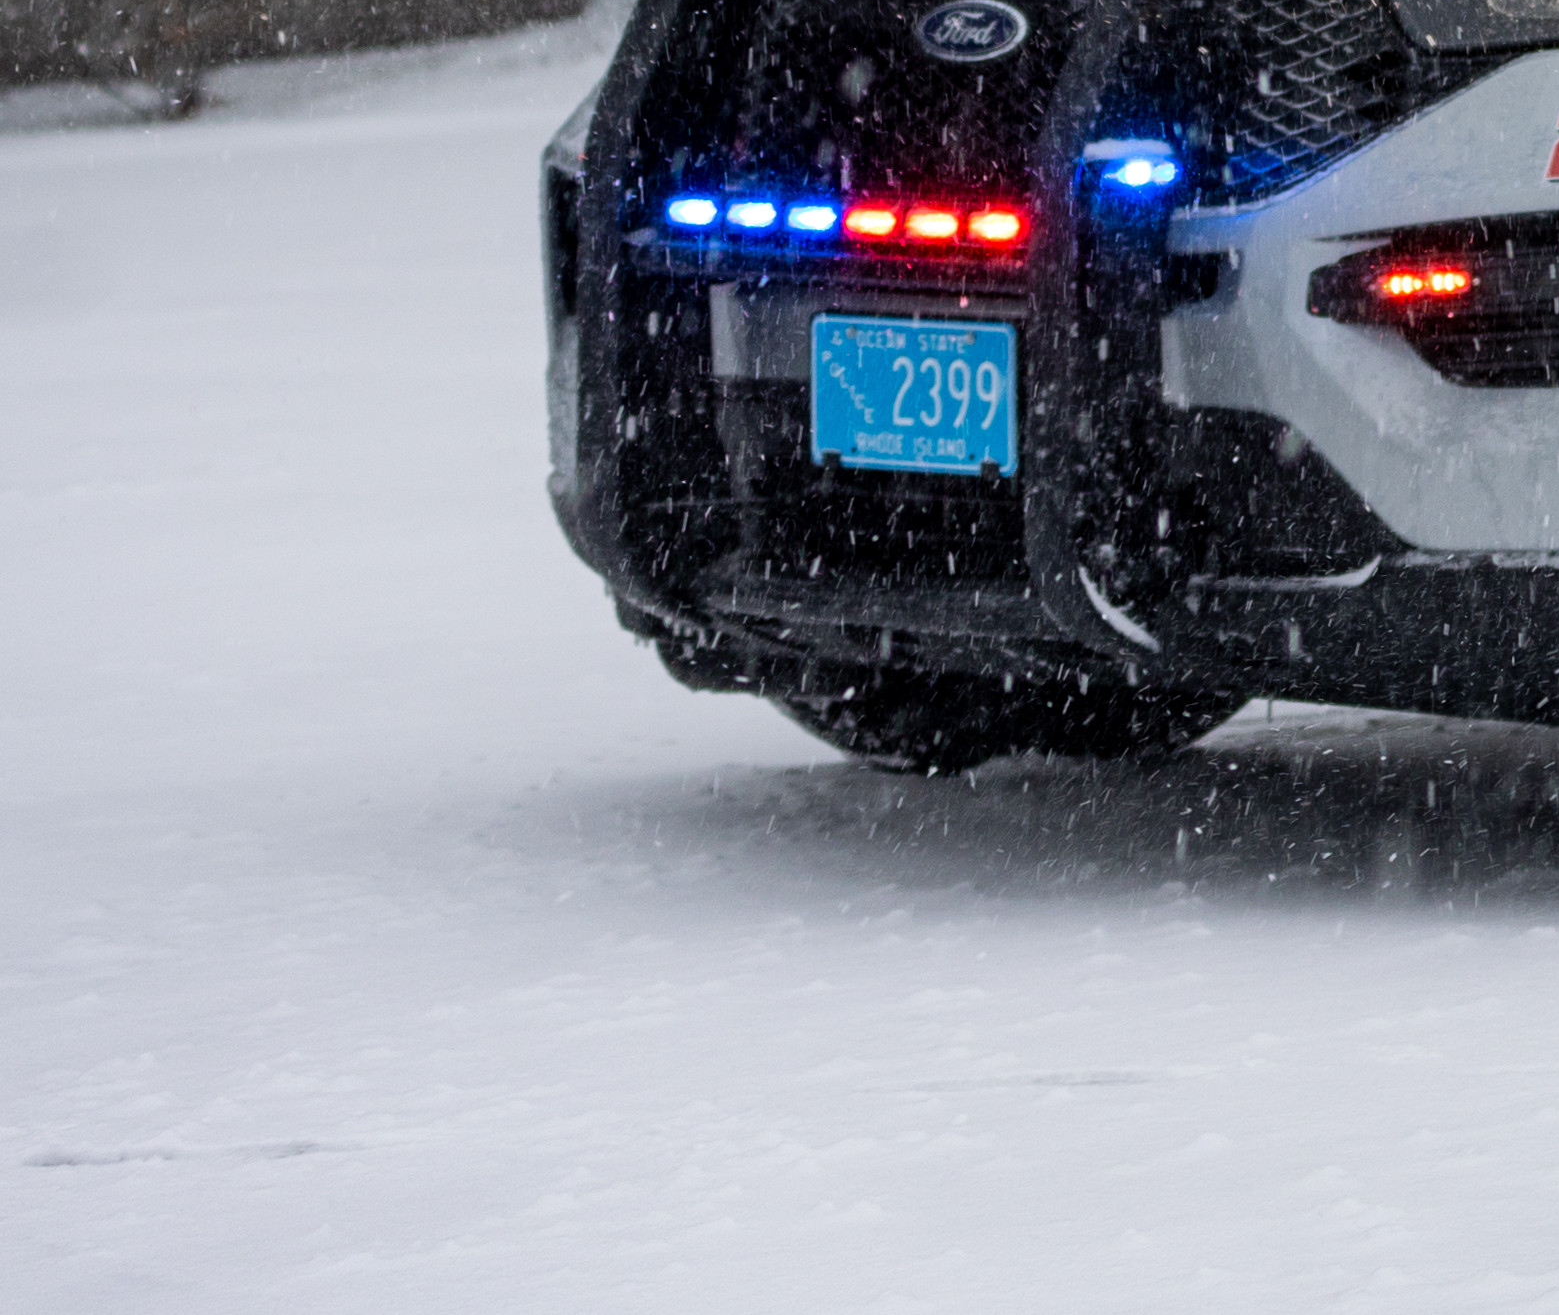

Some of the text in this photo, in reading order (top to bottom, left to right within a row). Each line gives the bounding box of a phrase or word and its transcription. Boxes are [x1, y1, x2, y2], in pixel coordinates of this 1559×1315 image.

[927, 11, 998, 45] Ford
[855, 329, 907, 349] OCEAN
[892, 355, 1000, 430] 2399
[855, 432, 967, 460] RHODE ISLAND
